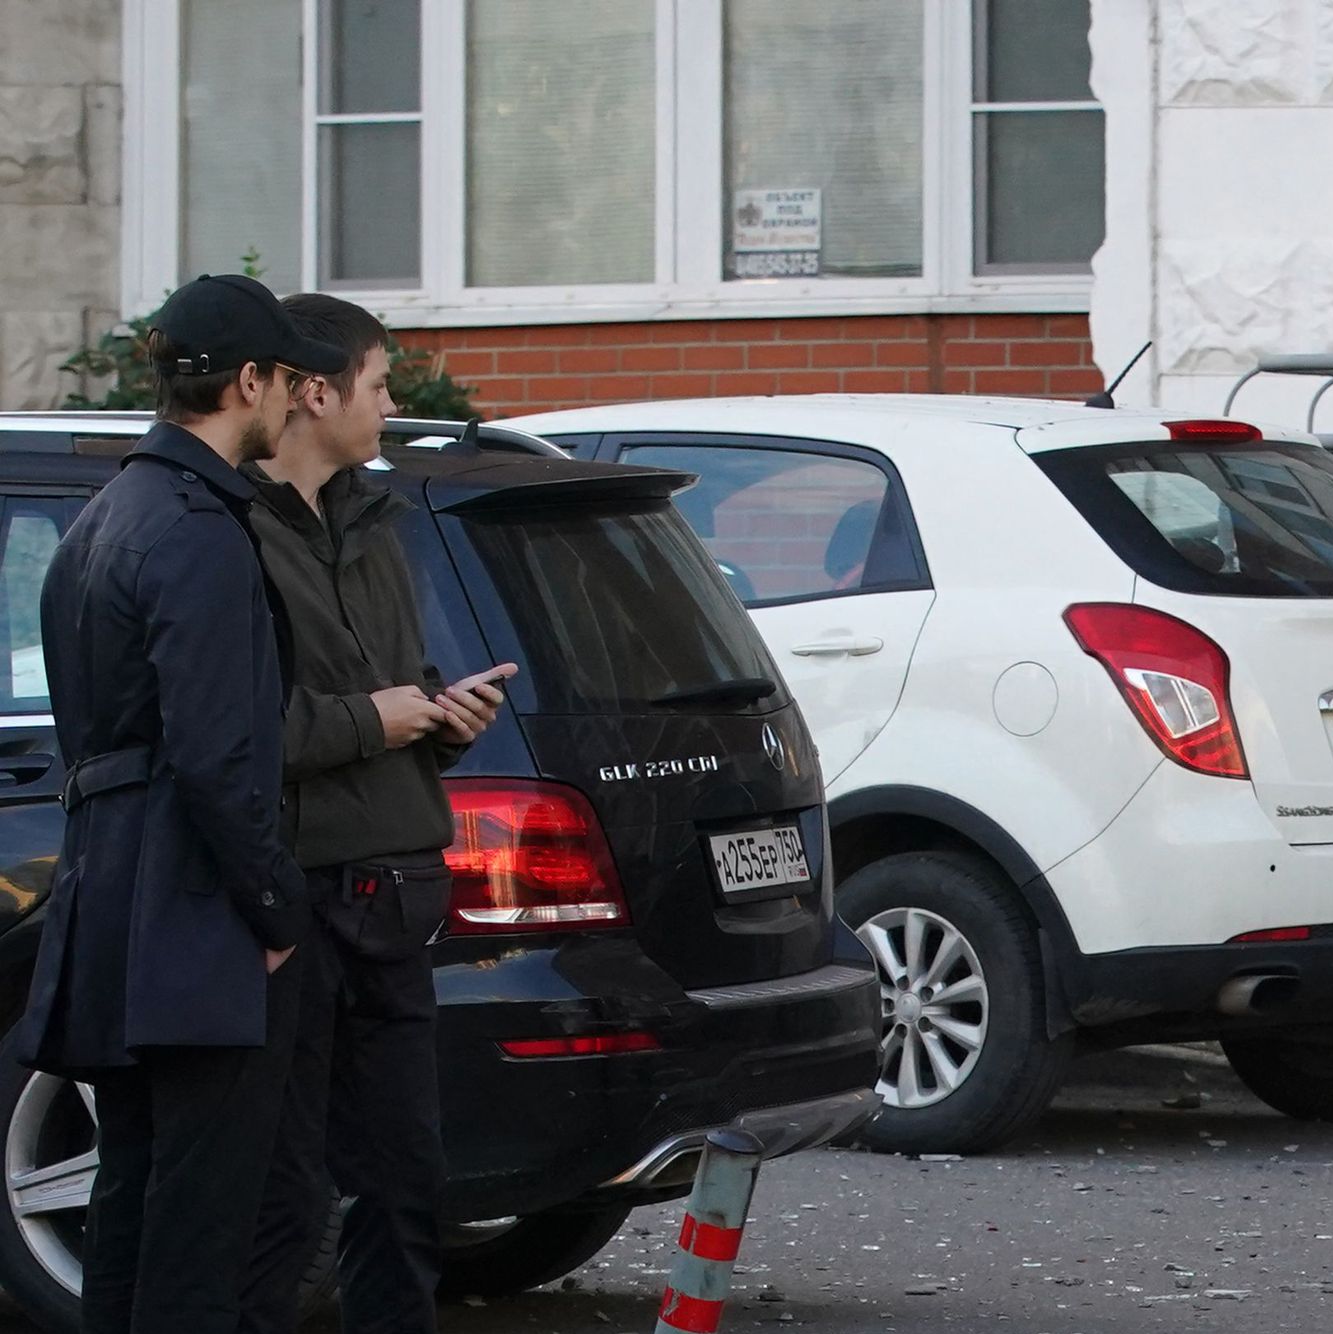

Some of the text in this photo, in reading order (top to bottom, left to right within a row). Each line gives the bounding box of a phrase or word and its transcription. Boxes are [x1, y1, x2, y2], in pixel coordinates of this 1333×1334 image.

[599, 755, 718, 781] GLK 220 CDI
[775, 830, 804, 864] 750
